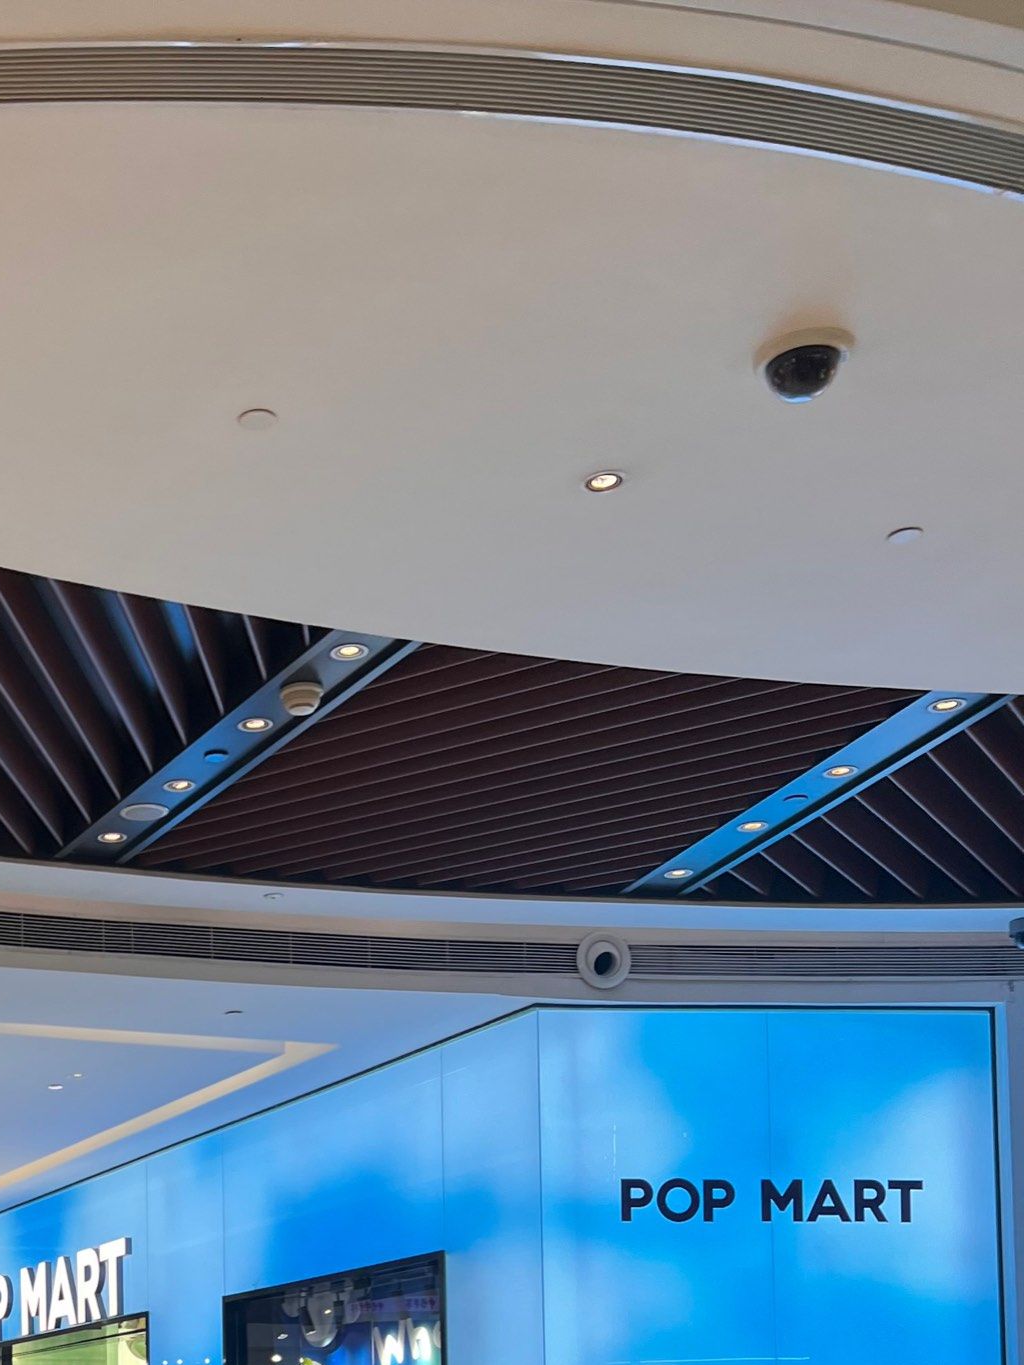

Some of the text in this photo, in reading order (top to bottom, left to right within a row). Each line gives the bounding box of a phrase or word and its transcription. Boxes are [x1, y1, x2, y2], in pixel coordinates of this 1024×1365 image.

[620, 1178, 924, 1223] POP MART
[20, 1237, 131, 1336] MART
